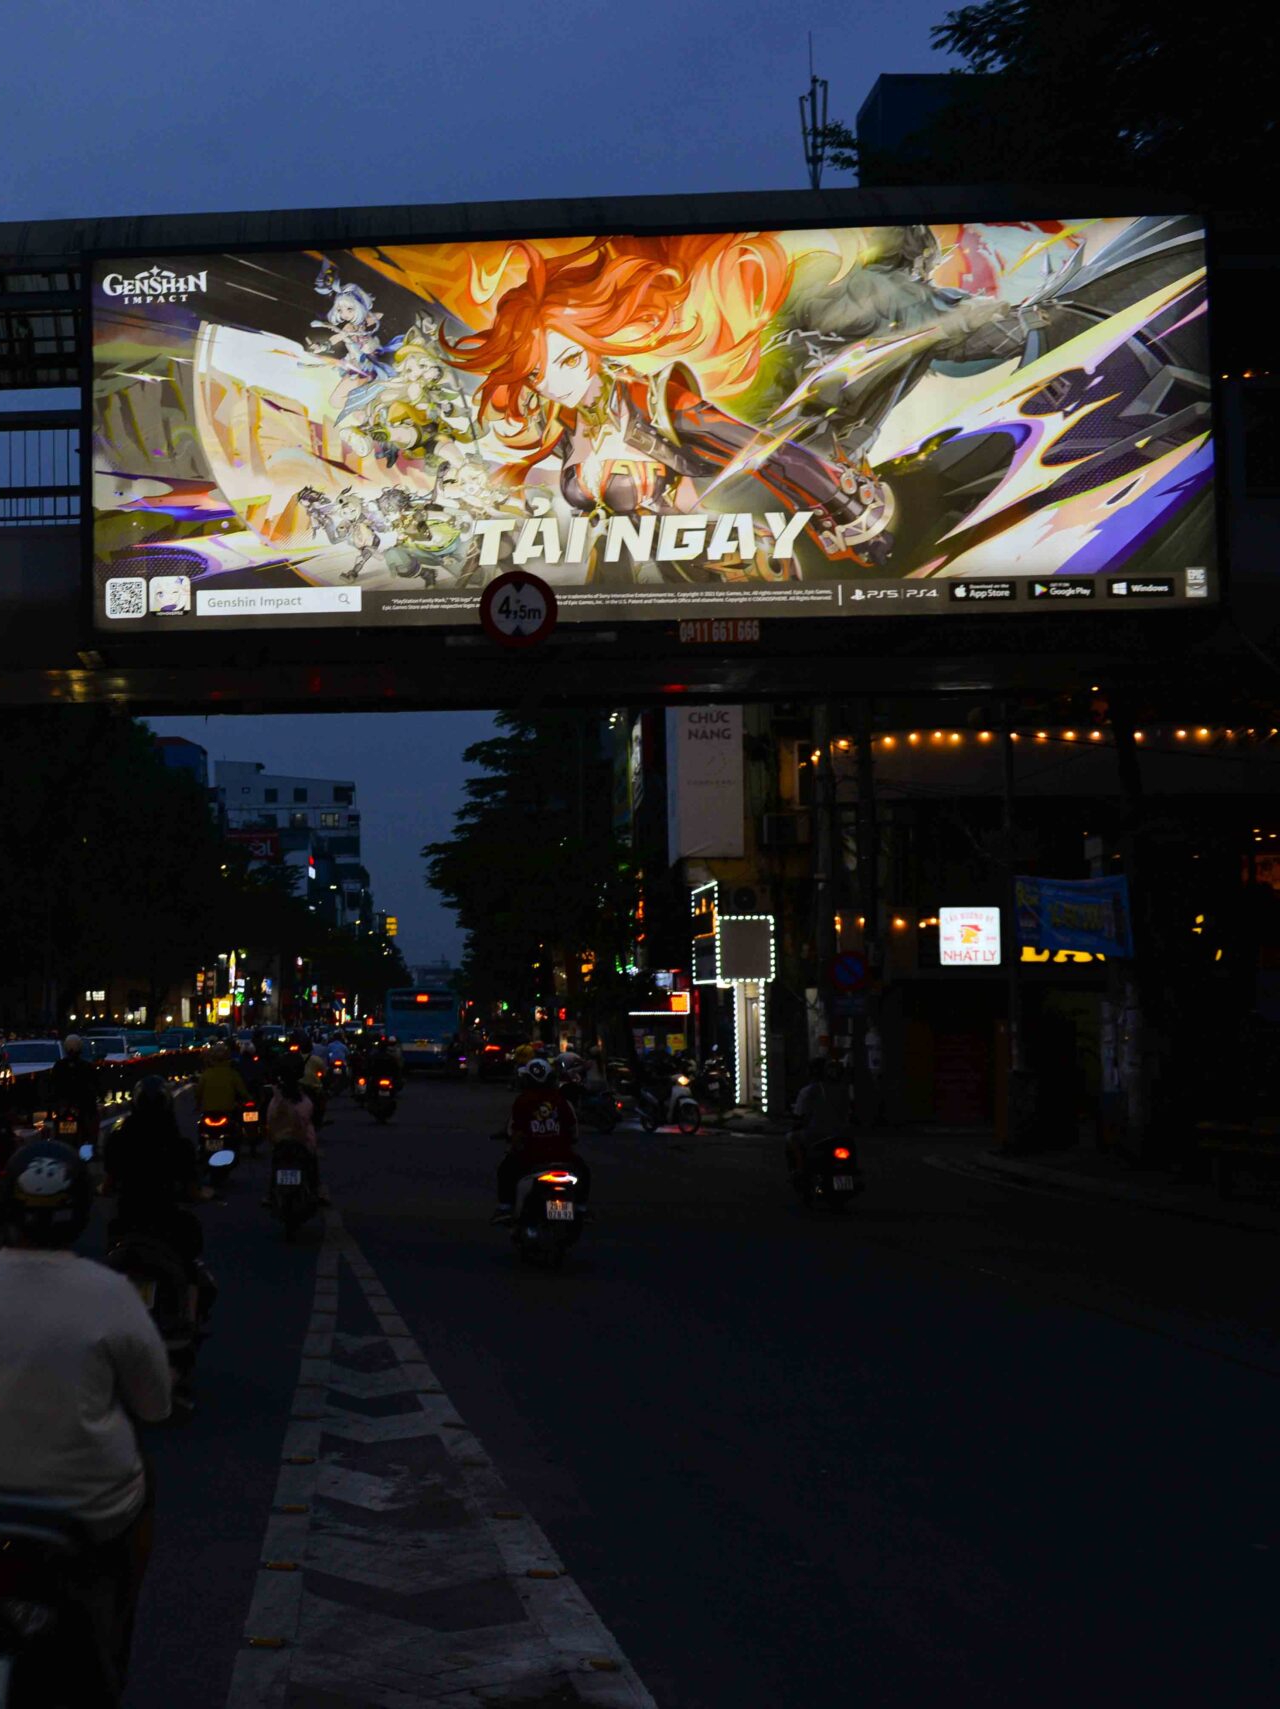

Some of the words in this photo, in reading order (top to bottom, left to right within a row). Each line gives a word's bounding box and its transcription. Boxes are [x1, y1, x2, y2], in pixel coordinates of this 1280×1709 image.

[102, 269, 208, 296] GENSHIN
[123, 294, 188, 304] IMPACT
[473, 497, 587, 566] TẢI
[604, 511, 814, 563] NGAY
[867, 589, 899, 599] PS5
[906, 588, 938, 598] PS4
[969, 590, 987, 599] App
[987, 589, 1010, 598] Store
[1050, 588, 1074, 597] Google
[1075, 587, 1091, 596] Play
[1131, 584, 1169, 592] Windows
[207, 597, 256, 608] Genshin
[260, 596, 302, 609] Impact
[680, 620, 710, 643] 0911
[712, 620, 734, 642] 661
[688, 710, 730, 724] CHỨC
[688, 726, 732, 740] NĂNG
